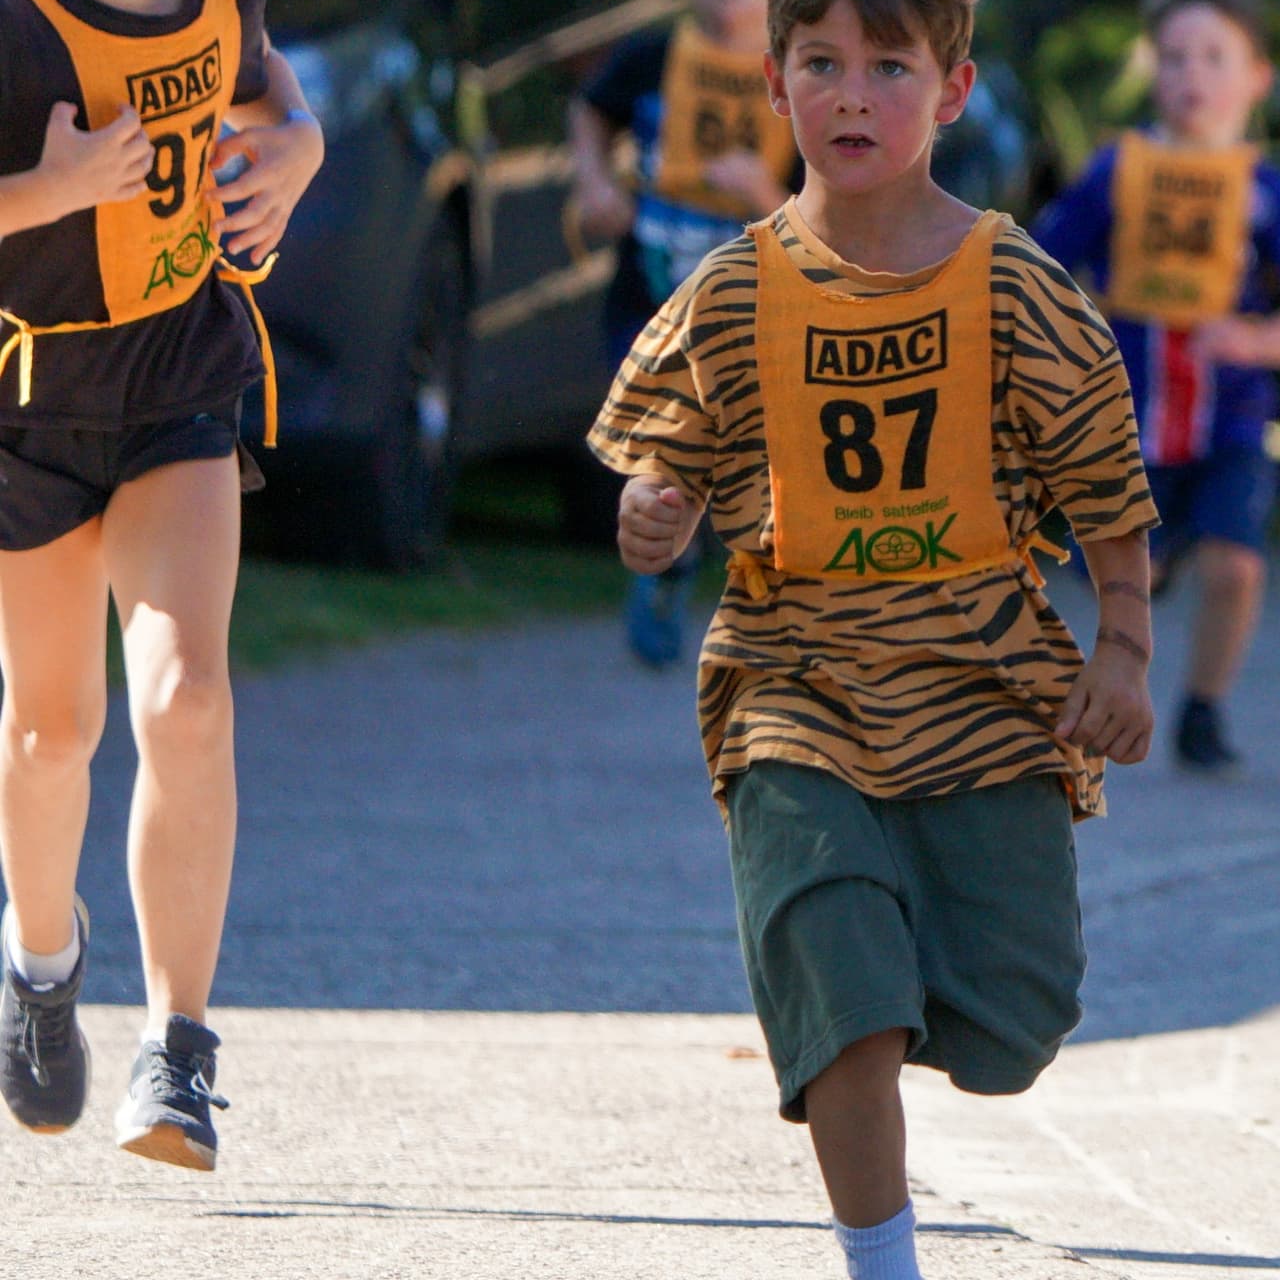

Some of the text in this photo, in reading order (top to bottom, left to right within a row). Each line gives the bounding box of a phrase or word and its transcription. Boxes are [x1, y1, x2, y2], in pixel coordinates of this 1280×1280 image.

[140, 55, 217, 115] ADAC
[145, 111, 215, 218] 97
[143, 207, 214, 300] AOK
[815, 325, 935, 377] ADAC
[819, 388, 938, 493] 87
[821, 512, 963, 577] AOK
[835, 505, 875, 521] Bleib
